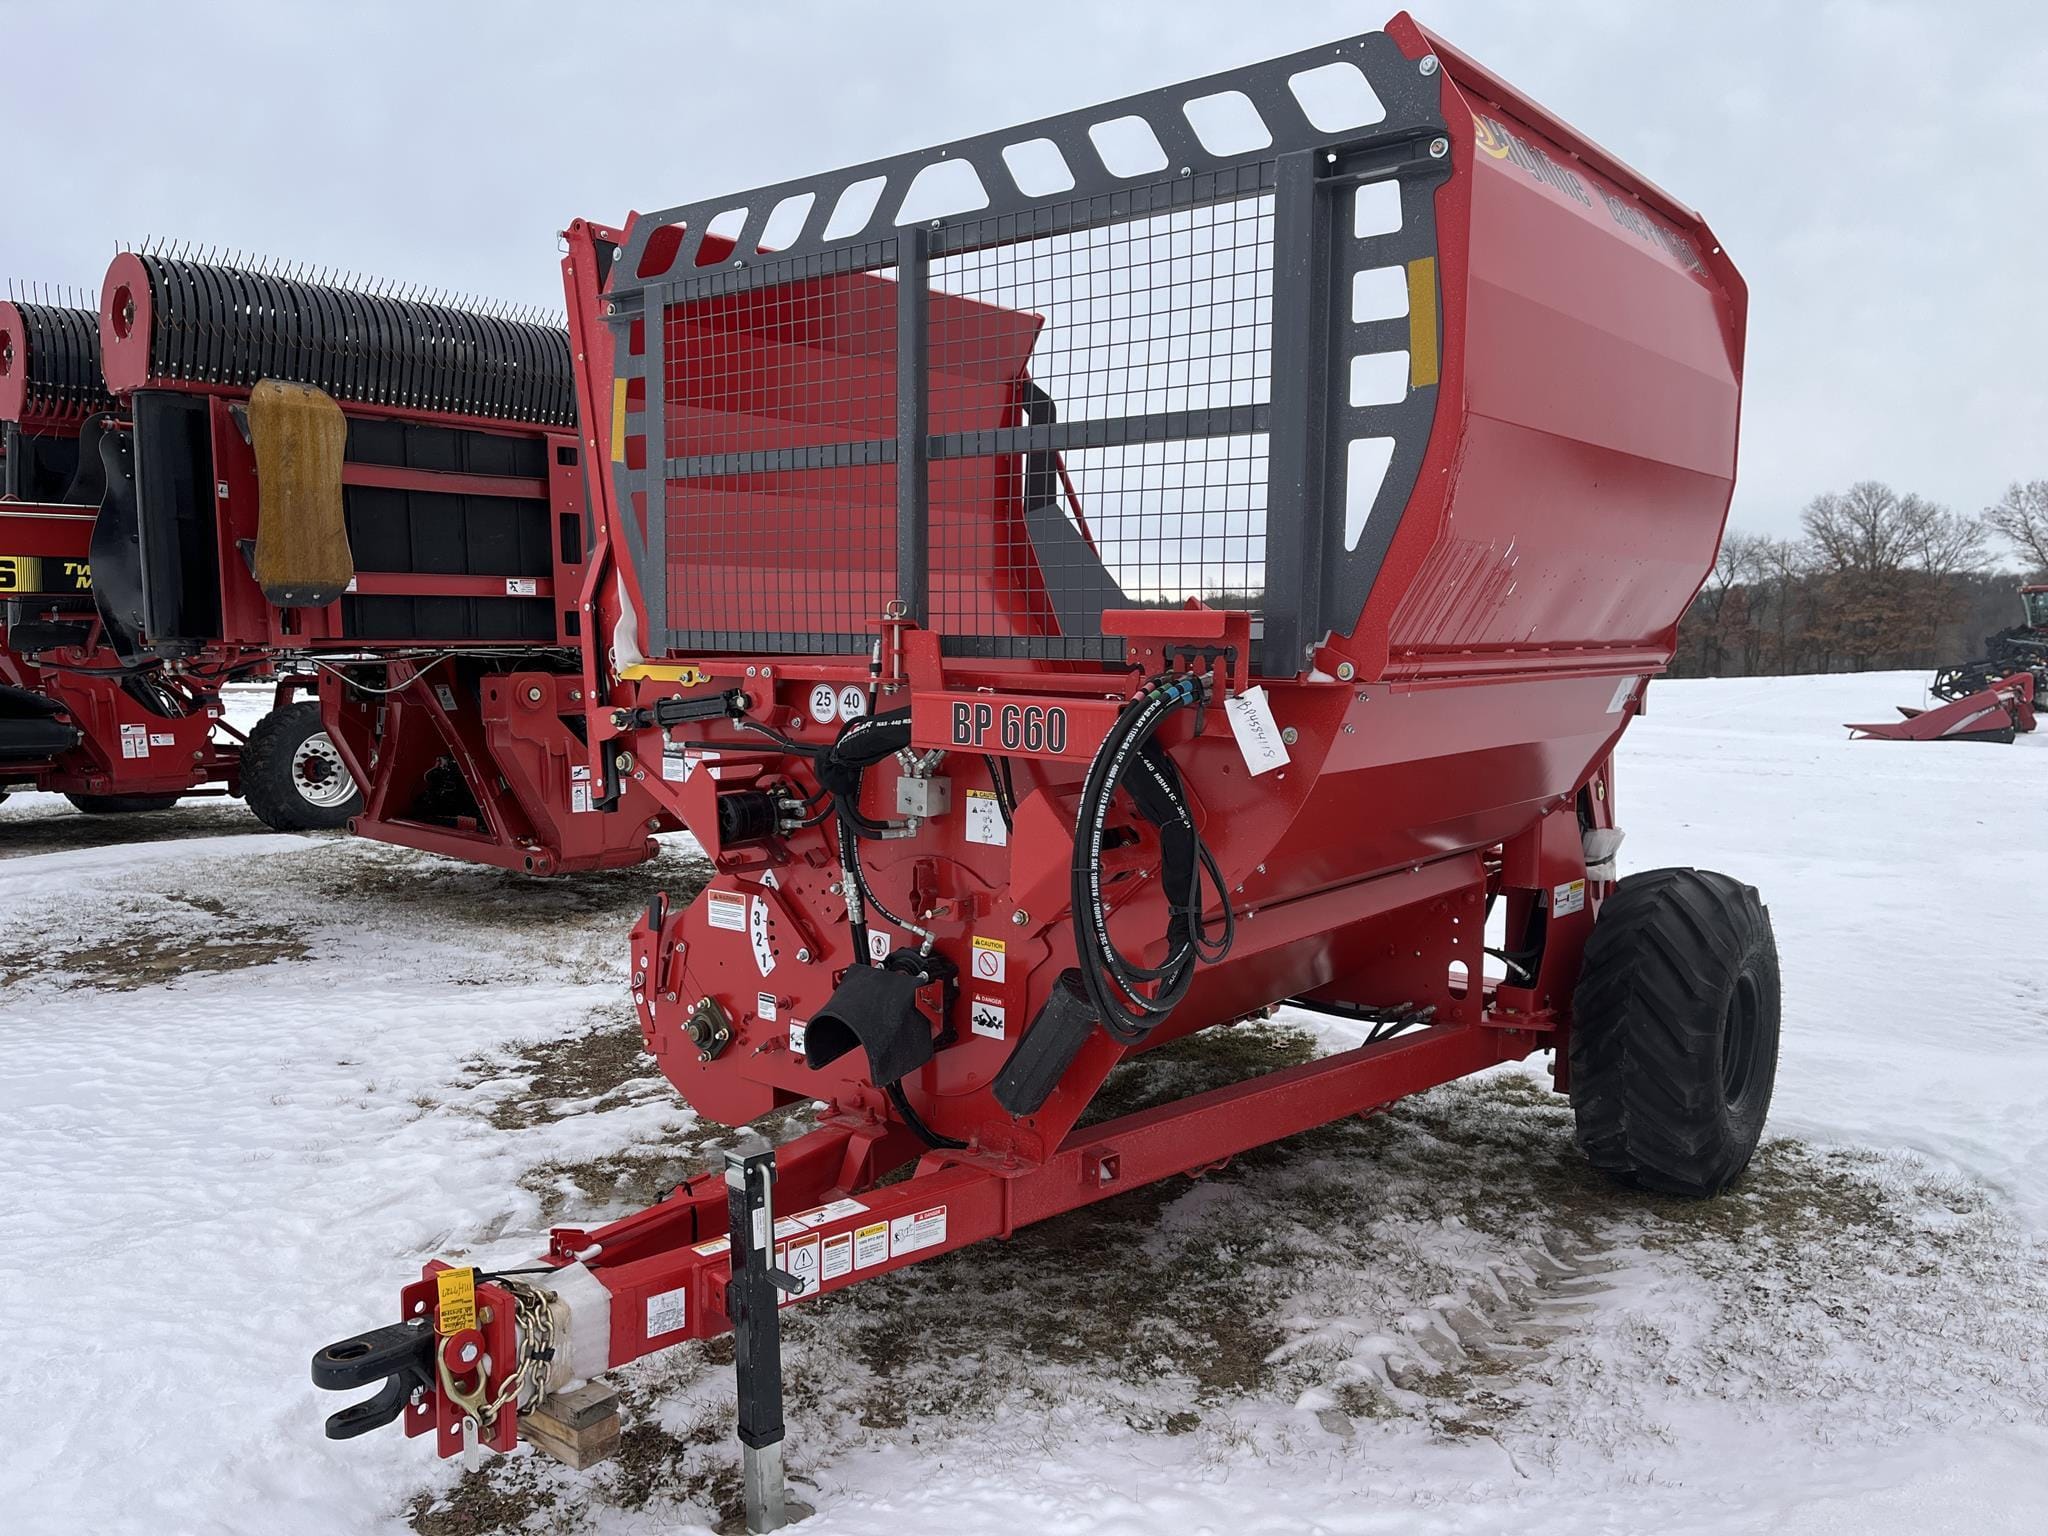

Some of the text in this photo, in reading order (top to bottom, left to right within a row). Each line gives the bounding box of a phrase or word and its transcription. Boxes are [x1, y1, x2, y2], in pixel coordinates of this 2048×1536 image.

[815, 691, 831, 707] 25
[844, 692, 859, 708] 40
[952, 702, 992, 746] BP
[1000, 704, 1066, 753] 660
[1144, 760, 1156, 772] 440
[1154, 772, 1170, 793] MSHA
[1168, 792, 1176, 802] IC
[1092, 830, 1101, 857] EXCEEDS
[754, 912, 760, 926] 3
[756, 932, 762, 946] 2
[980, 940, 1003, 950] CAUTION
[761, 954, 767, 968] 1
[982, 996, 1002, 1006] DANGER
